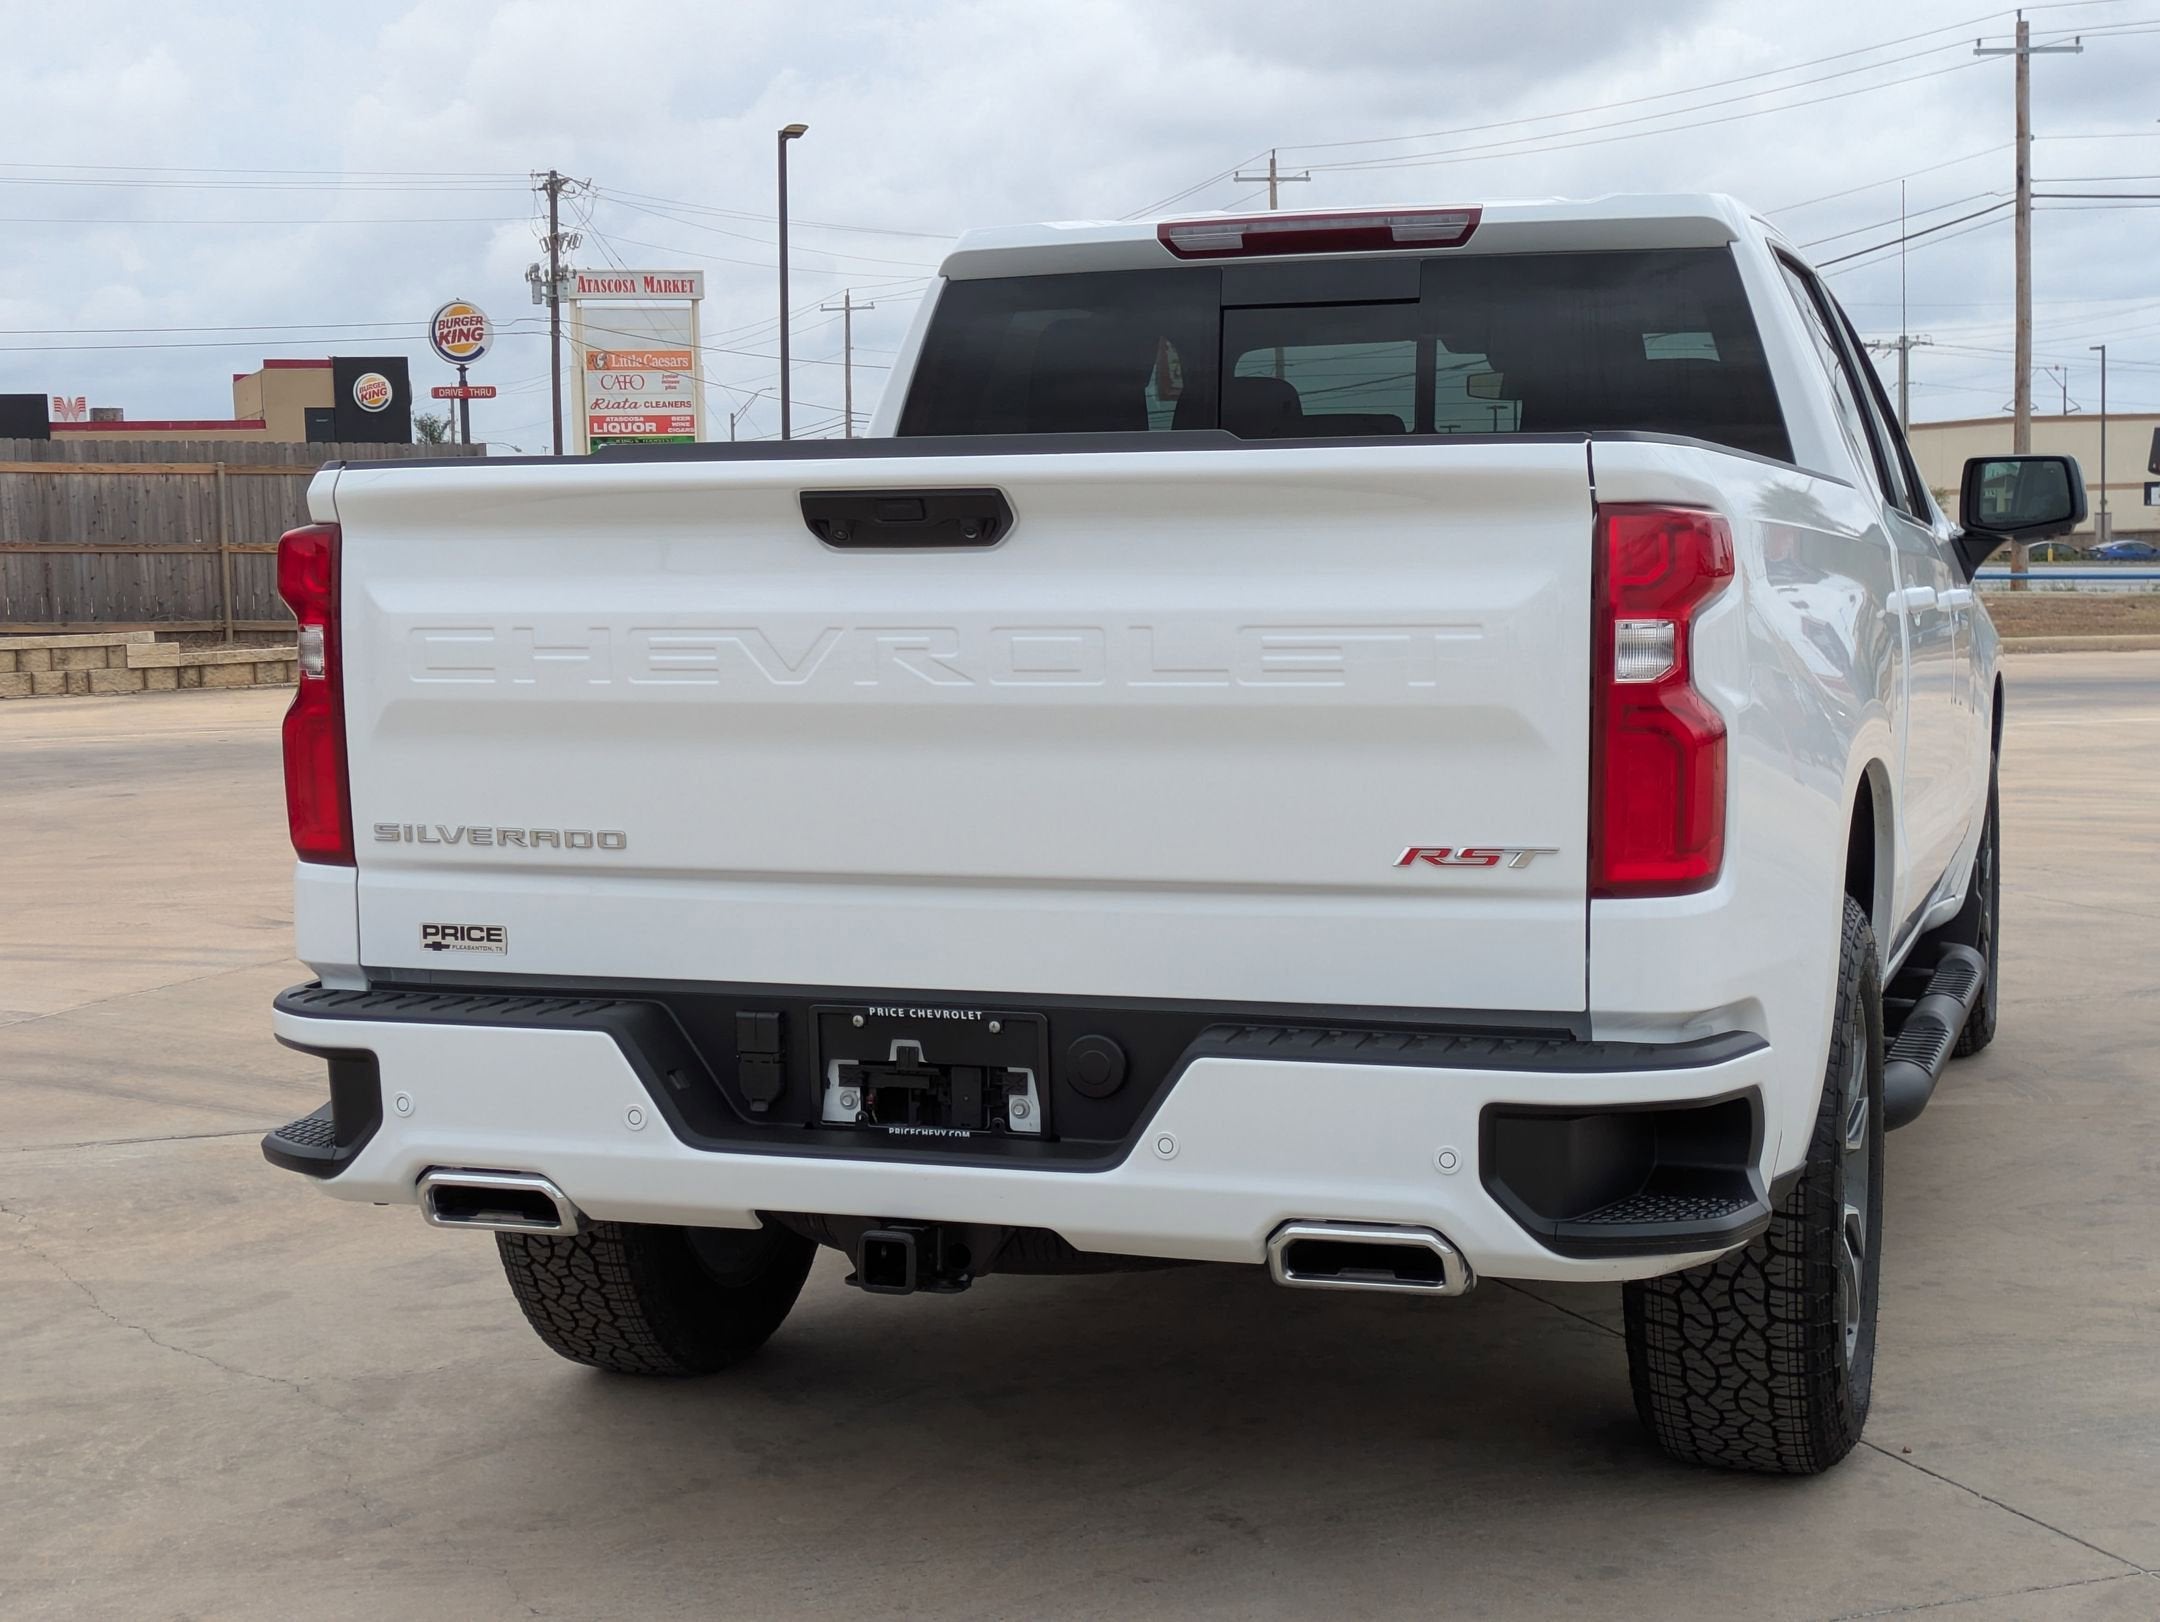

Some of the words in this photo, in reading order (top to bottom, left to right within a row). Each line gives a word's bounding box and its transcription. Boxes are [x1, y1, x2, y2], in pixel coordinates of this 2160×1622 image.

[577, 276, 636, 293] ATASCOSA
[644, 276, 695, 293] MARKET
[438, 316, 483, 331] BURGER
[438, 327, 485, 347] KING
[611, 353, 642, 367] Little
[643, 354, 689, 367] Caesars
[359, 381, 386, 394] BURGER
[360, 387, 388, 402] KING
[438, 388, 463, 397] DRIVE
[469, 388, 492, 397] THRU
[590, 398, 642, 410] Riata
[644, 401, 692, 409] CLEANERS
[593, 422, 657, 433] LIQUOR
[408, 625, 1486, 689] CHEVROLET
[373, 822, 627, 850] SILVERADO
[1392, 846, 1560, 868] RST
[422, 924, 503, 943] PRICE
[451, 944, 494, 952] PLEASANTON,
[869, 1007, 905, 1017] PRICE
[909, 1008, 983, 1020] CHEVROLET
[888, 1127, 970, 1137] PRICECHEVYCOM
